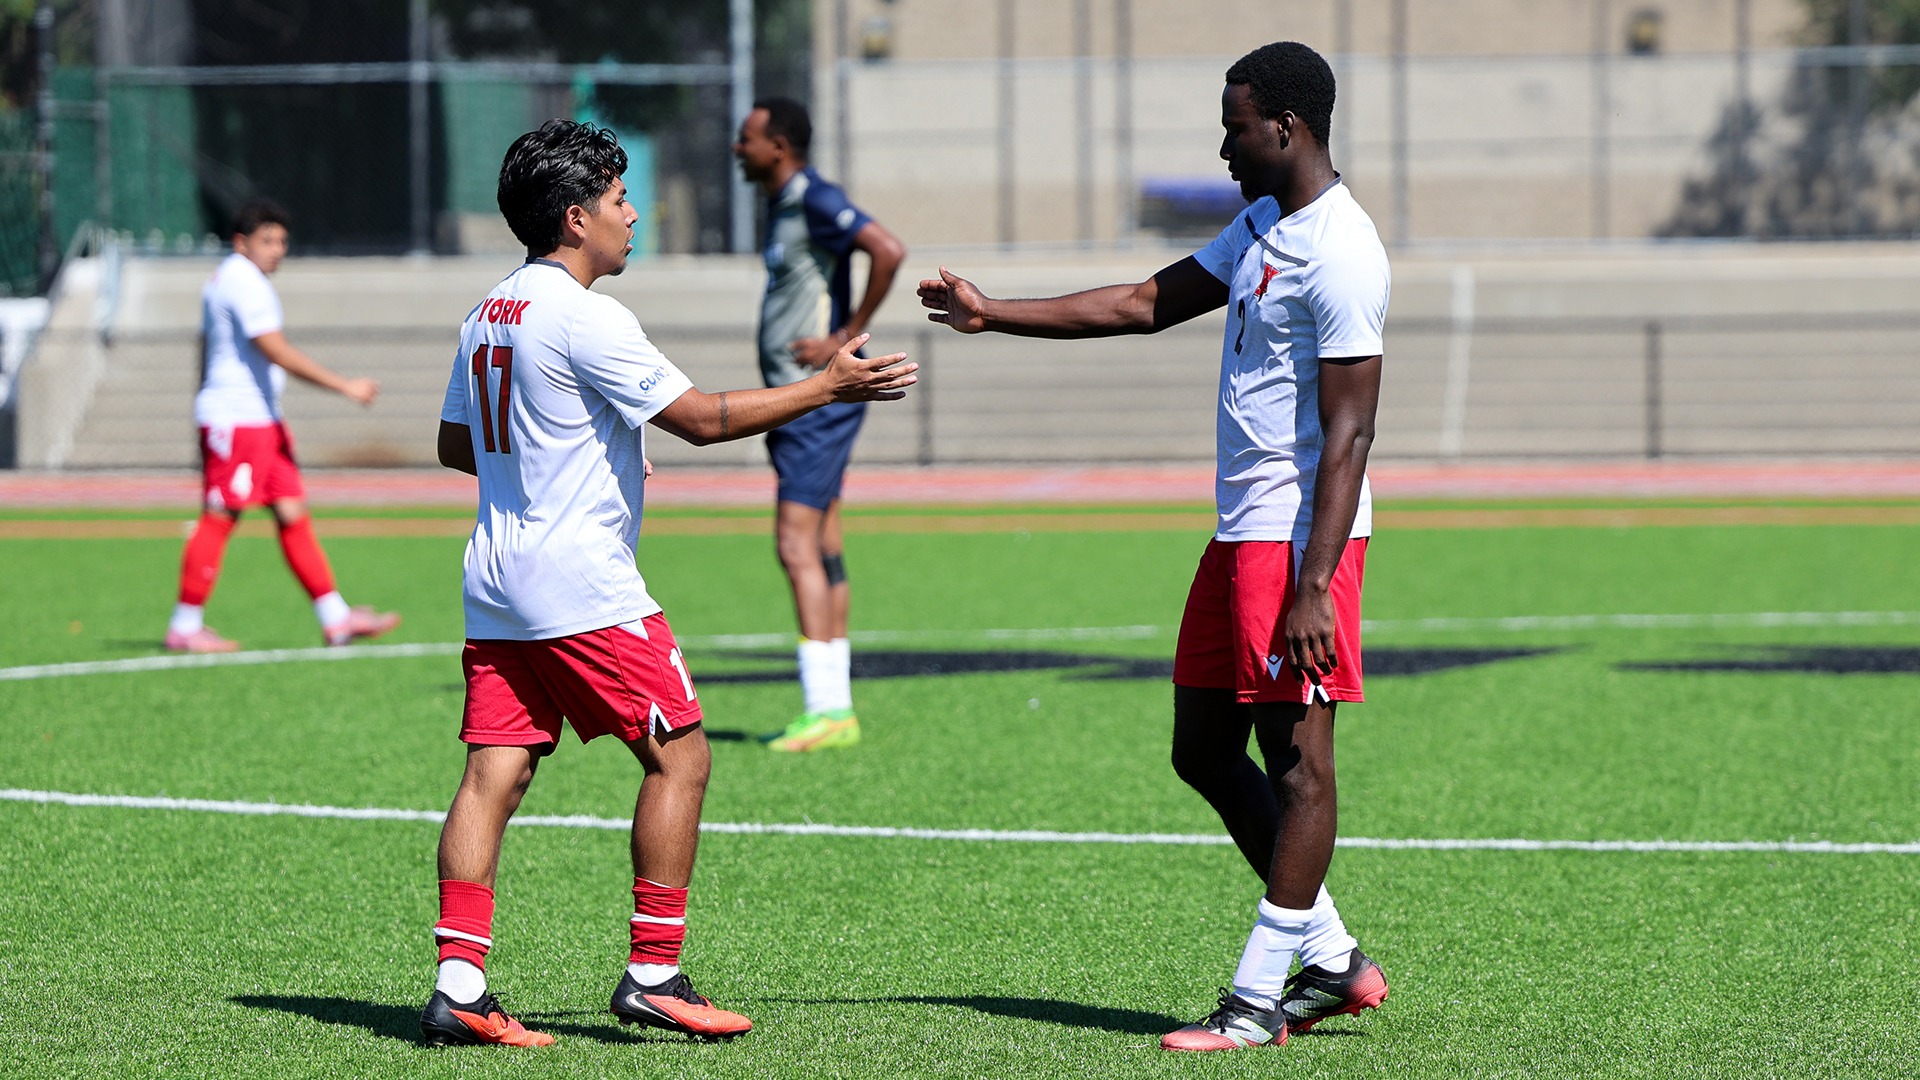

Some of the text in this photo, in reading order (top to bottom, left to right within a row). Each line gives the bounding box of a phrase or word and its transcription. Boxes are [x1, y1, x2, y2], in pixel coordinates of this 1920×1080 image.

[477, 298, 531, 325] YORK
[1234, 298, 1246, 356] 2
[472, 343, 514, 454] 17
[639, 366, 669, 391] CUN
[669, 646, 697, 702] 1
